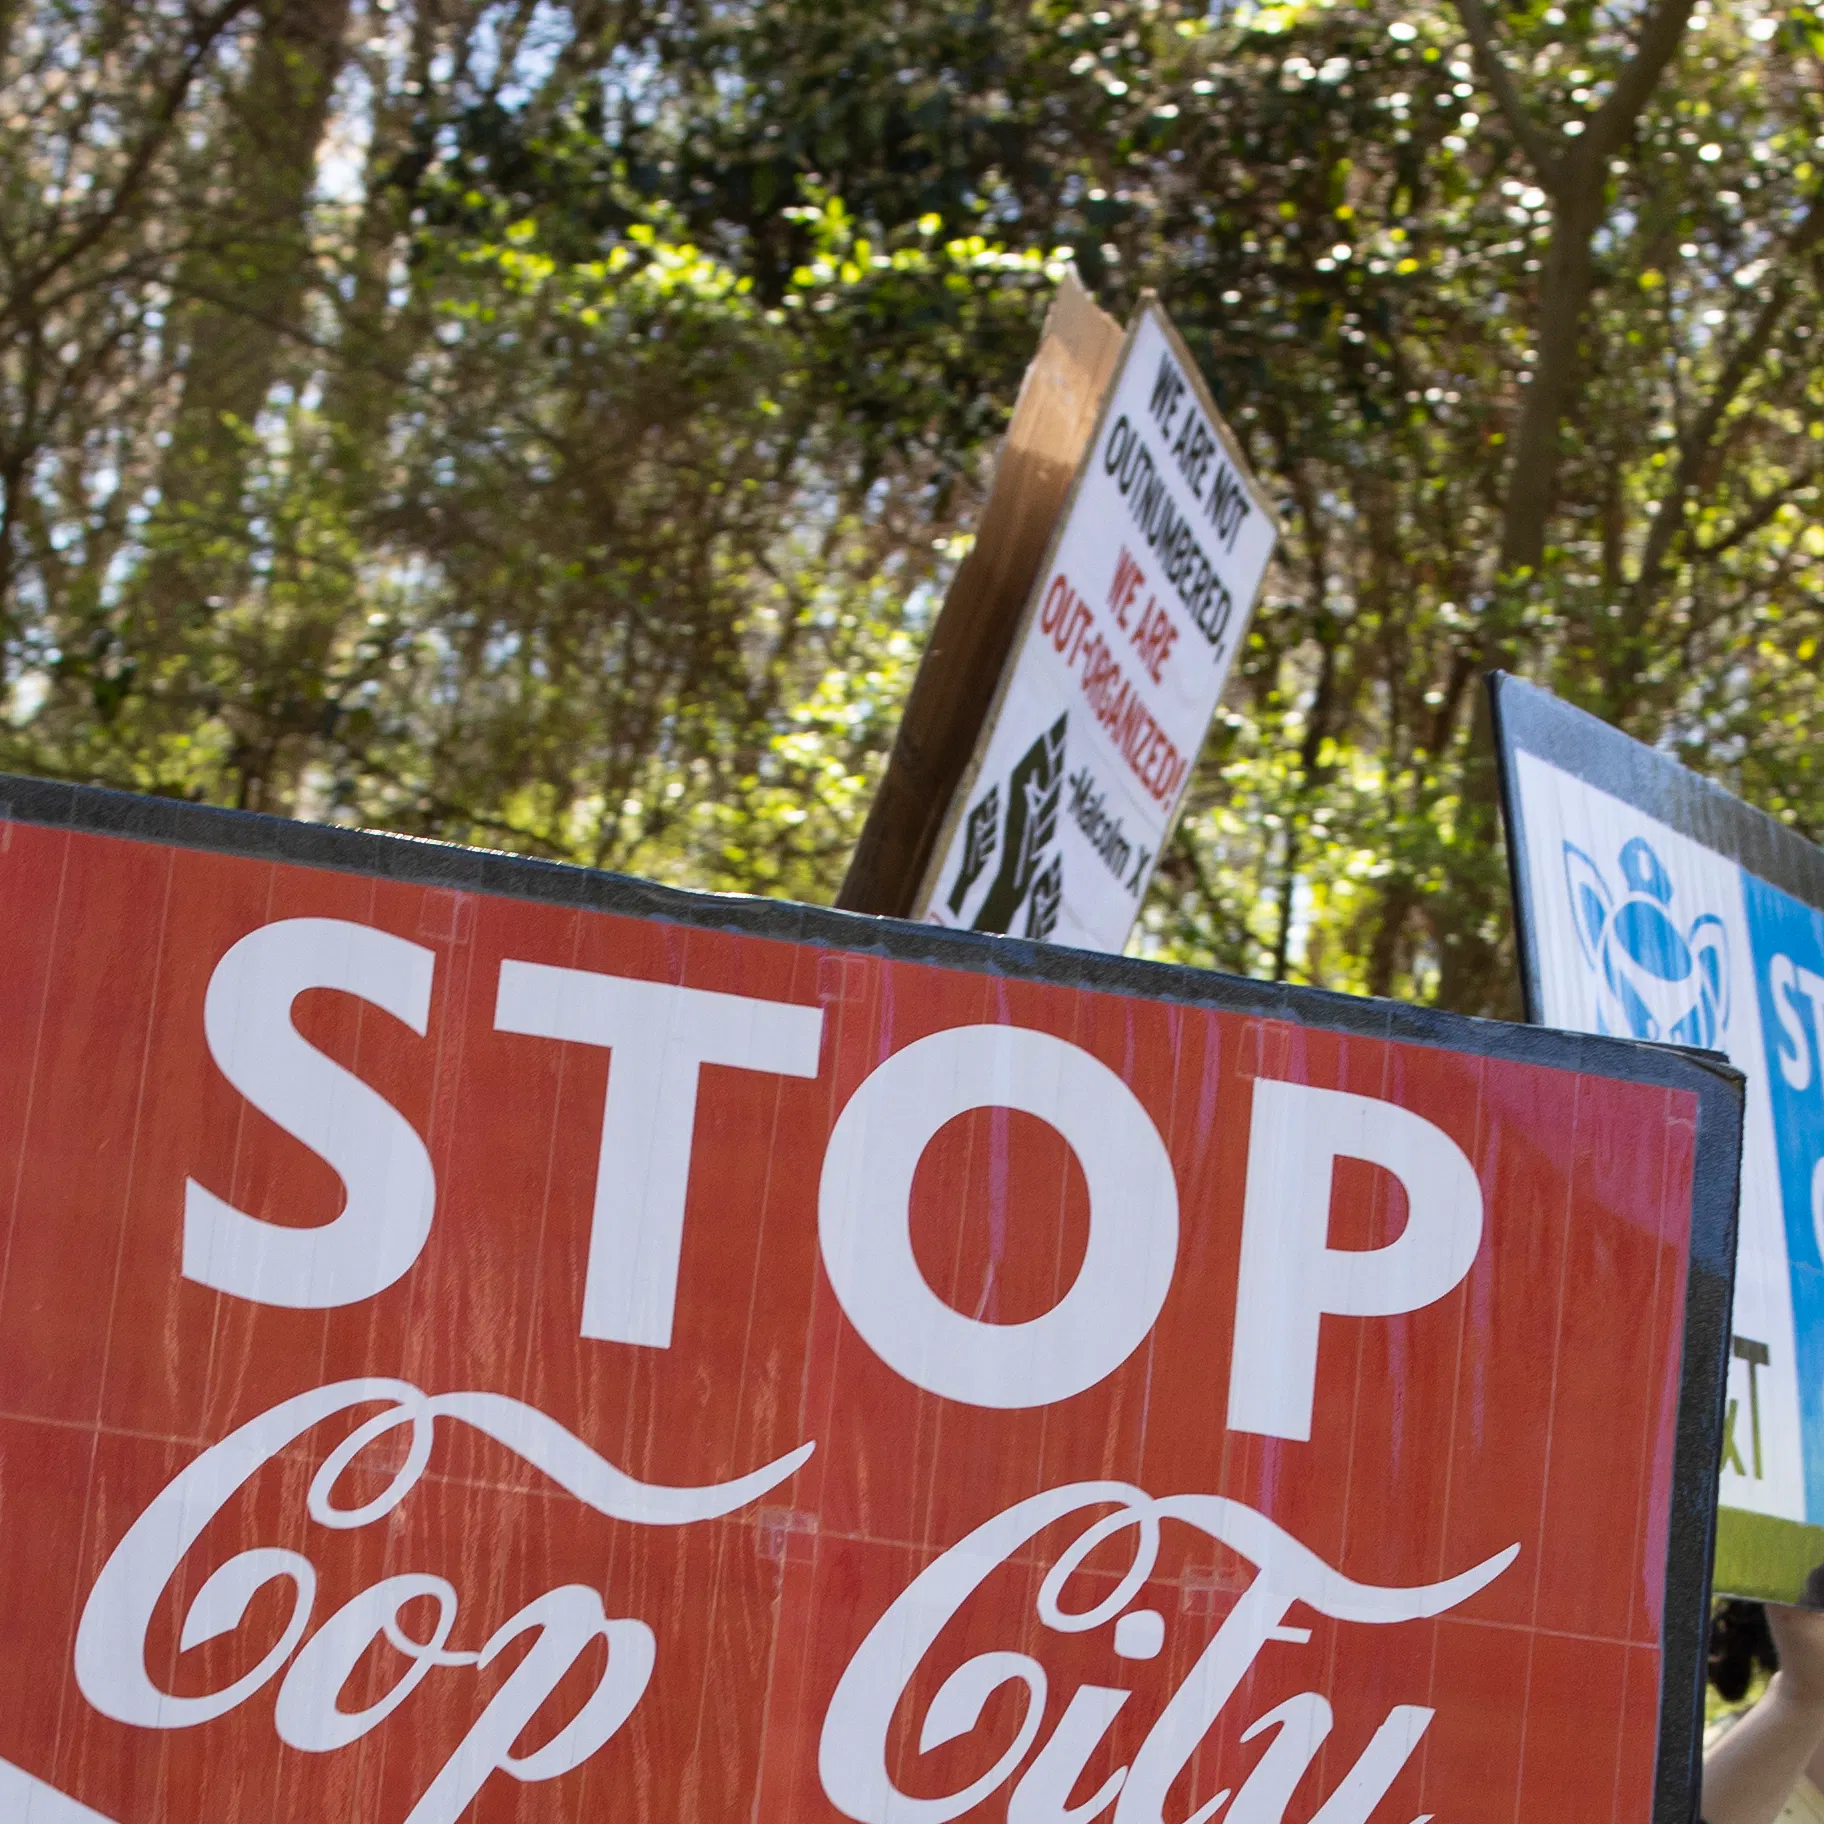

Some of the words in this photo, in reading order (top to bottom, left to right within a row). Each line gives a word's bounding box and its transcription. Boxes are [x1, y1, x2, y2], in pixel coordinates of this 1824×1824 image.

[1148, 352, 1185, 441] WE
[1171, 407, 1216, 500] ARE
[1204, 460, 1252, 556] NOT
[1107, 545, 1146, 631] WE
[1130, 595, 1179, 686] ARE
[1125, 843, 1153, 899] X
[182, 916, 1485, 1442] STOP
